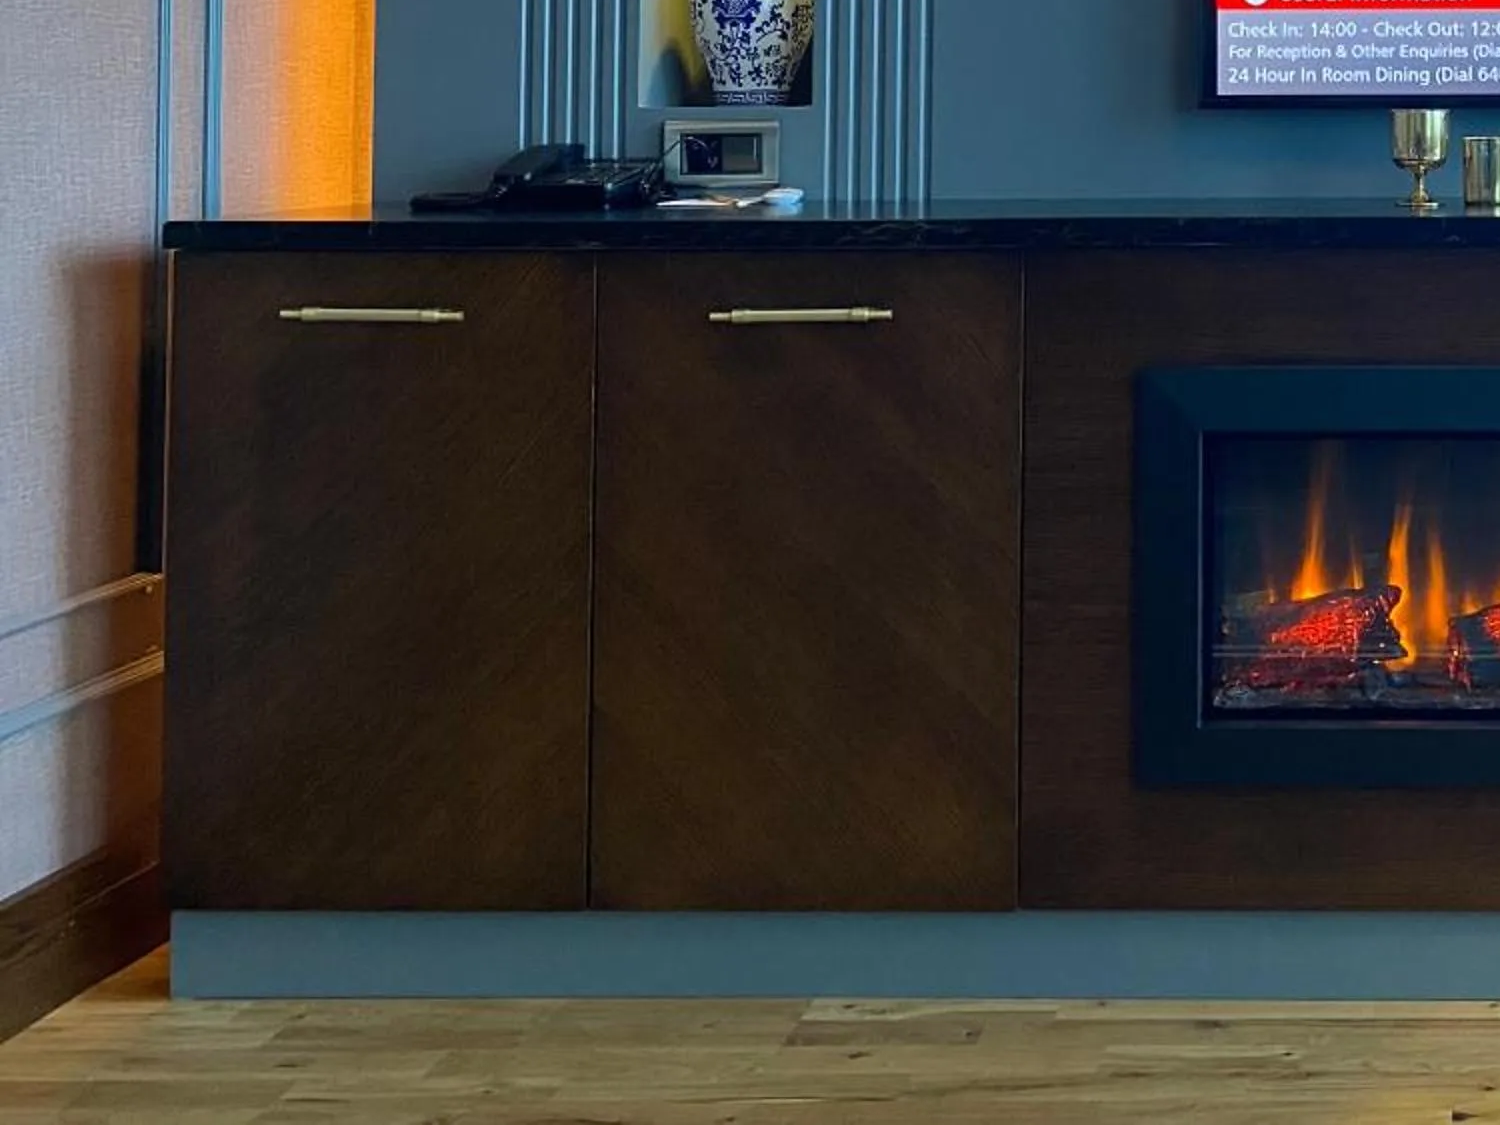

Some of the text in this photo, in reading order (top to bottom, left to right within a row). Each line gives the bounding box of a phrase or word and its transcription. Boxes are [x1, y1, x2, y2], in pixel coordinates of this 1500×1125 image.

[1228, 20, 1278, 38] Check
[1283, 22, 1303, 38] In:
[1311, 21, 1357, 38] 14:00
[1373, 20, 1424, 37] Check
[1428, 21, 1465, 37] Out:
[1229, 45, 1252, 59] For
[1257, 43, 1332, 62] Reception
[1336, 45, 1348, 59] &
[1351, 43, 1395, 59] Other
[1400, 43, 1469, 62] Enquiries
[1227, 68, 1249, 83] 24
[1255, 67, 1296, 83] Hour
[1301, 67, 1317, 83] In
[1322, 67, 1371, 83] Room
[1375, 66, 1431, 86] Dining
[1435, 65, 1474, 86] (Dial
